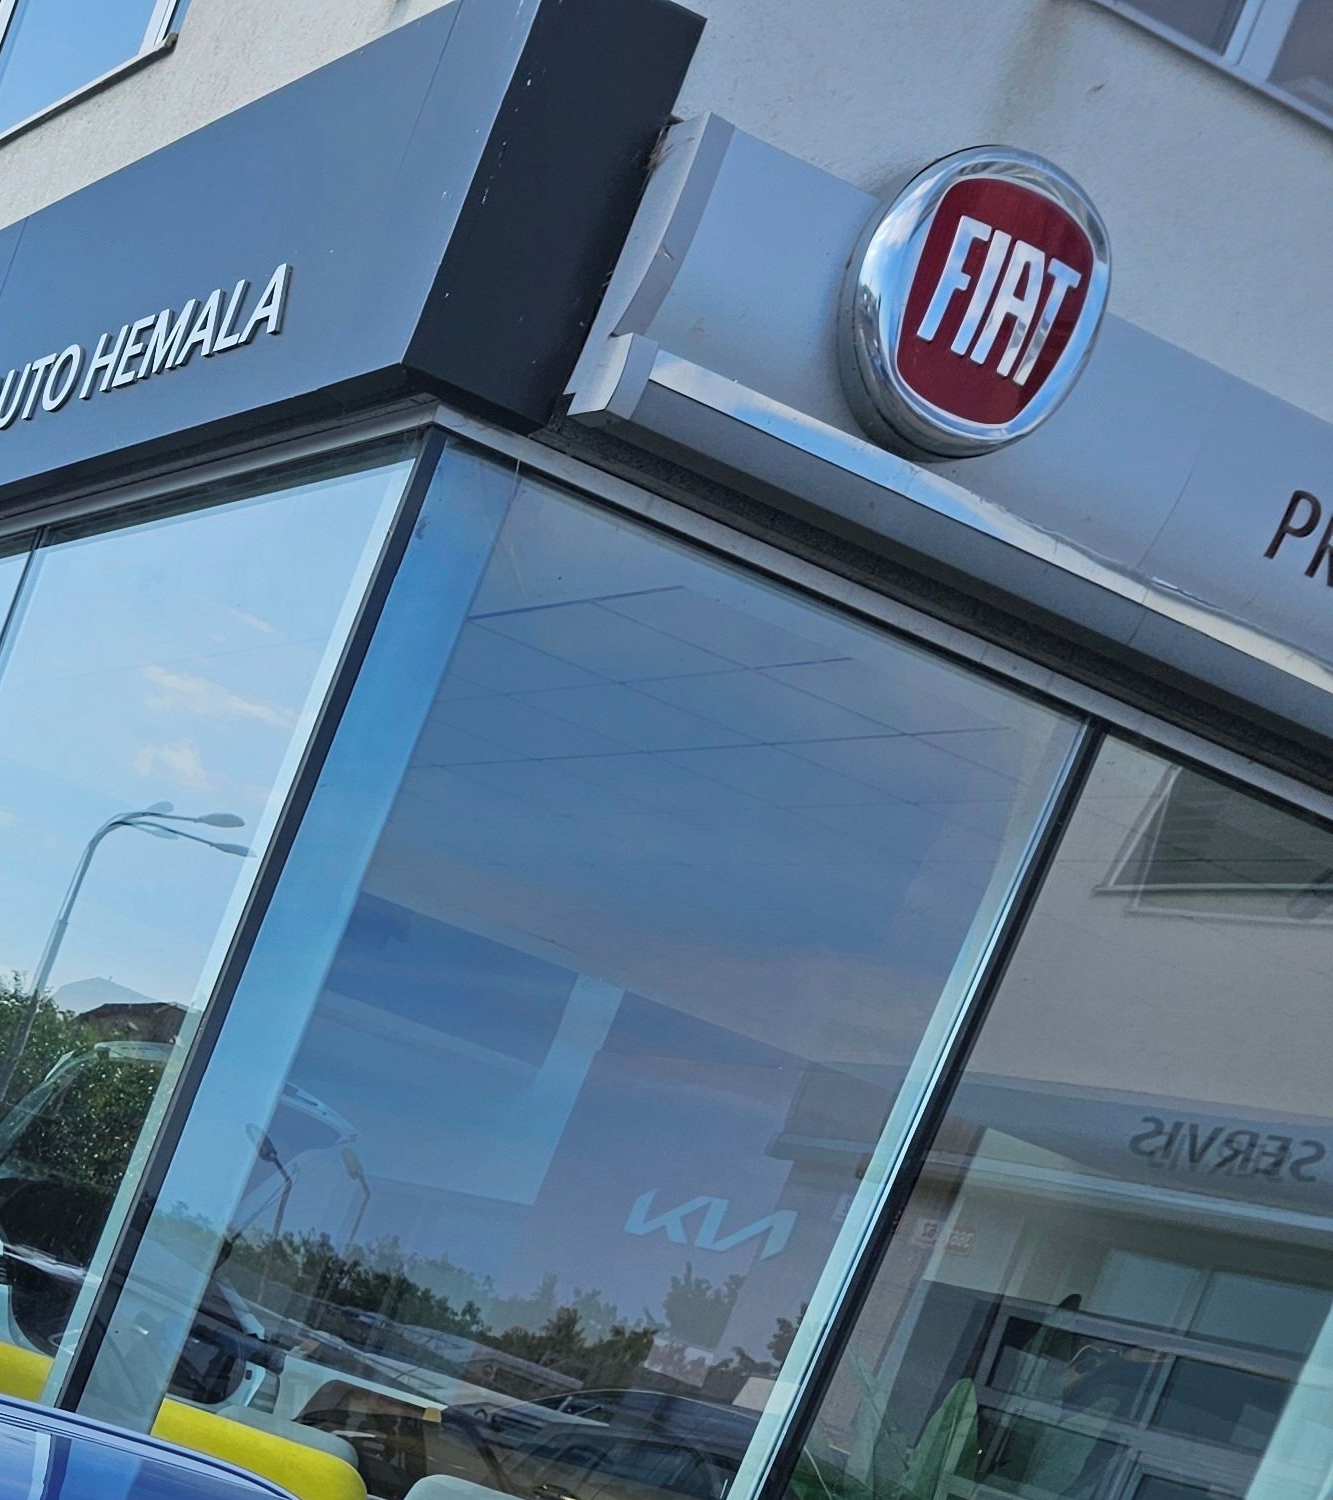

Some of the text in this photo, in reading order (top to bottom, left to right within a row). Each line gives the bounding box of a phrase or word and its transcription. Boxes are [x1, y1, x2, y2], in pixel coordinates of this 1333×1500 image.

[79, 263, 292, 400] HEMALA
[916, 215, 1082, 387] FIAT
[623, 1186, 798, 1261] KIA
